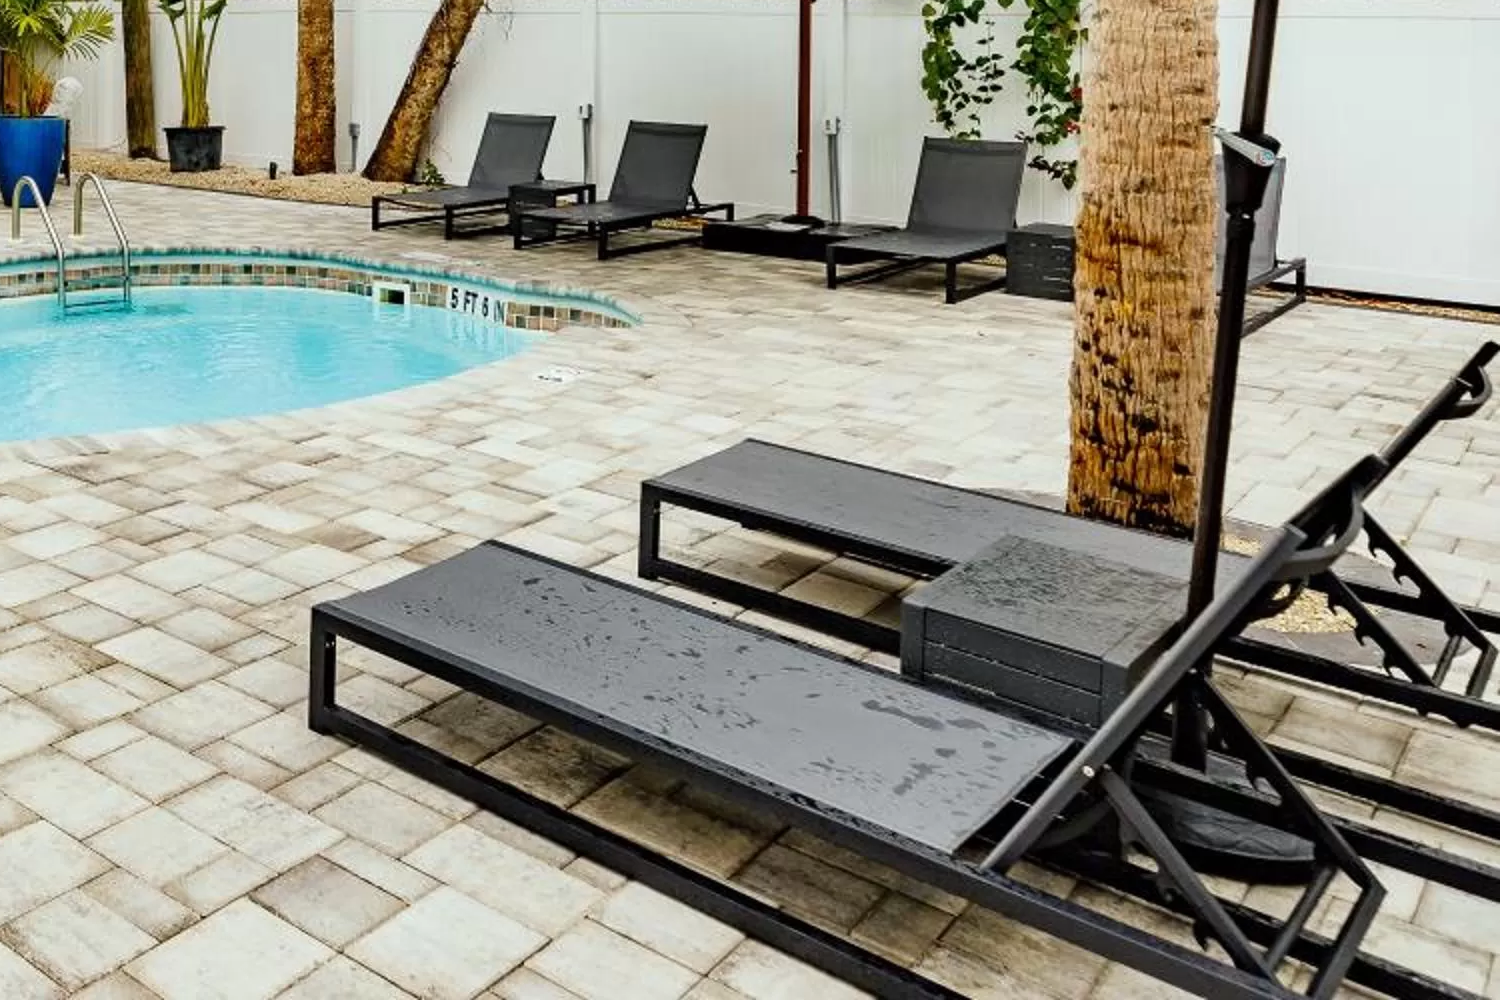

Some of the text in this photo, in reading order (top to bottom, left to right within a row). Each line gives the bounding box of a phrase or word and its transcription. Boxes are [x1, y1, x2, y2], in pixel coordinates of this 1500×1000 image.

[451, 287, 459, 309] 5
[463, 290, 479, 313] FT
[482, 296, 489, 317] 6
